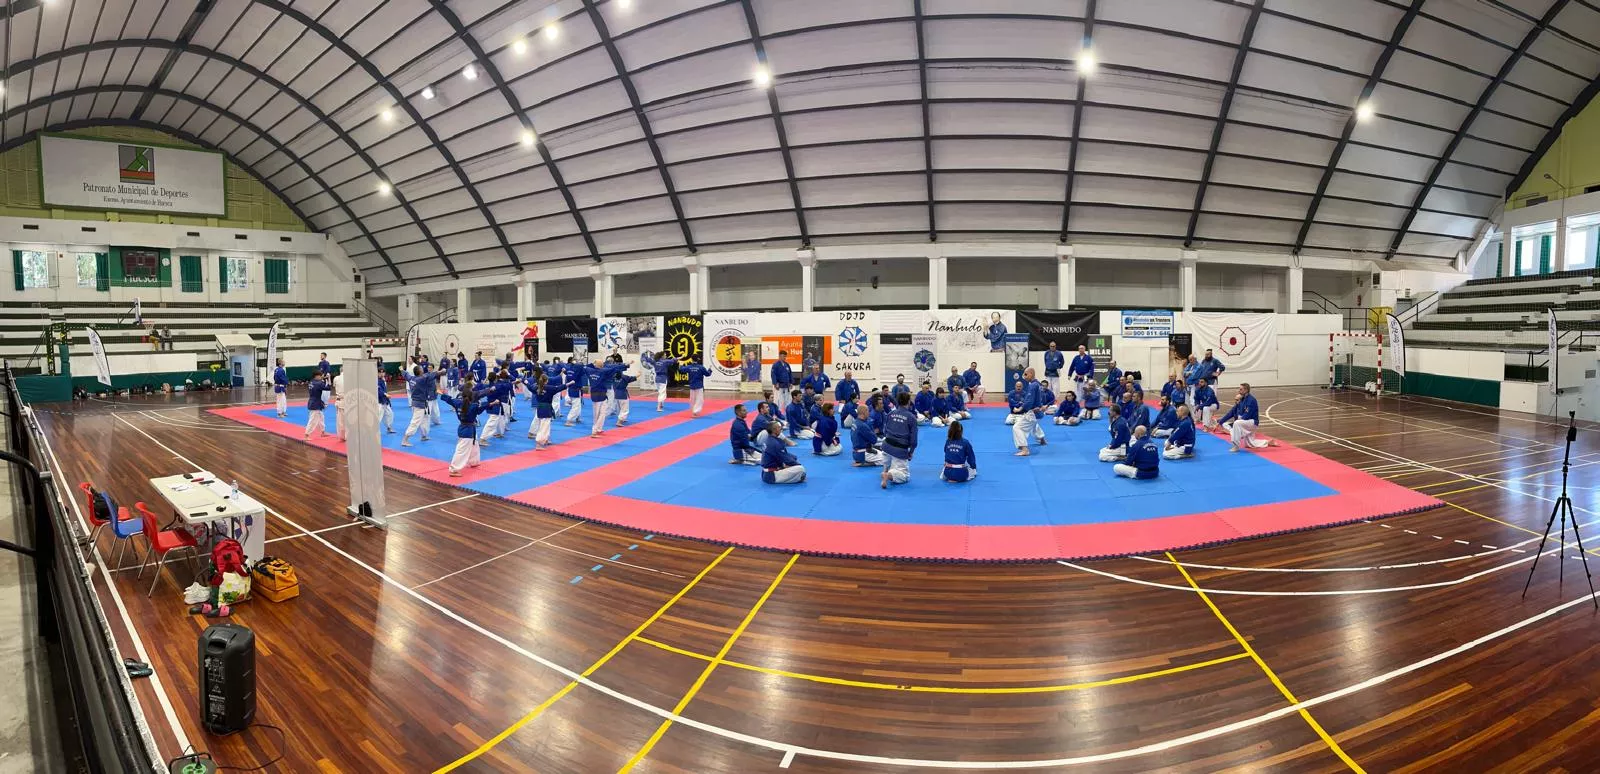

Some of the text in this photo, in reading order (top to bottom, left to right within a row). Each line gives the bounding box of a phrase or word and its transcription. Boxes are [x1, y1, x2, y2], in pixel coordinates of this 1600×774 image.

[83, 183, 189, 199] Patronato Municipal de Deportes
[121, 197, 152, 205] Ayuntamiento
[668, 316, 702, 327] NANBUDO
[928, 318, 982, 332] Nanbudo
[1042, 326, 1082, 334] NANBUDO
[836, 362, 871, 371] SAKURA
